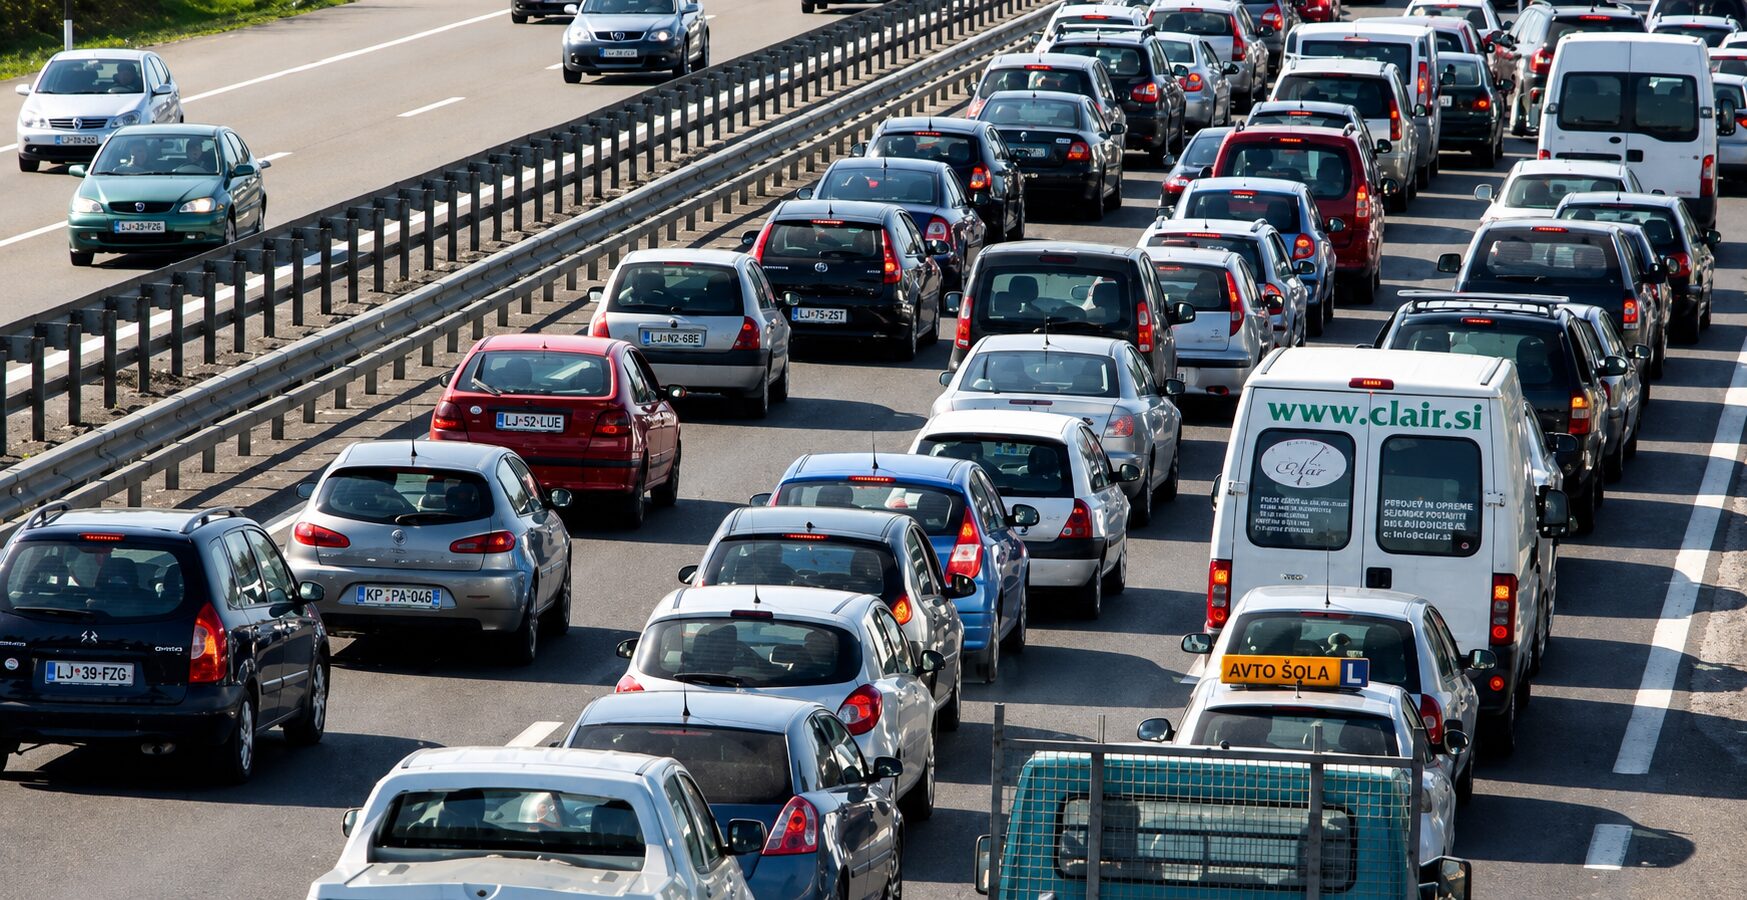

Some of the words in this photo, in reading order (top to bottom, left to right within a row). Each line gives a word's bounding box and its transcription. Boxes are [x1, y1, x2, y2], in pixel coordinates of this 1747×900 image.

[800, 309, 812, 319] LJ
[651, 333, 663, 343] LJ
[505, 415, 519, 427] LJ
[1267, 400, 1482, 430] www.clair.si
[366, 588, 383, 601] KP
[391, 589, 432, 603] PA-046
[57, 665, 74, 679] LJ
[1228, 663, 1276, 679] AVTO
[1281, 659, 1330, 681] ŠOLA
[1346, 662, 1362, 684] L
